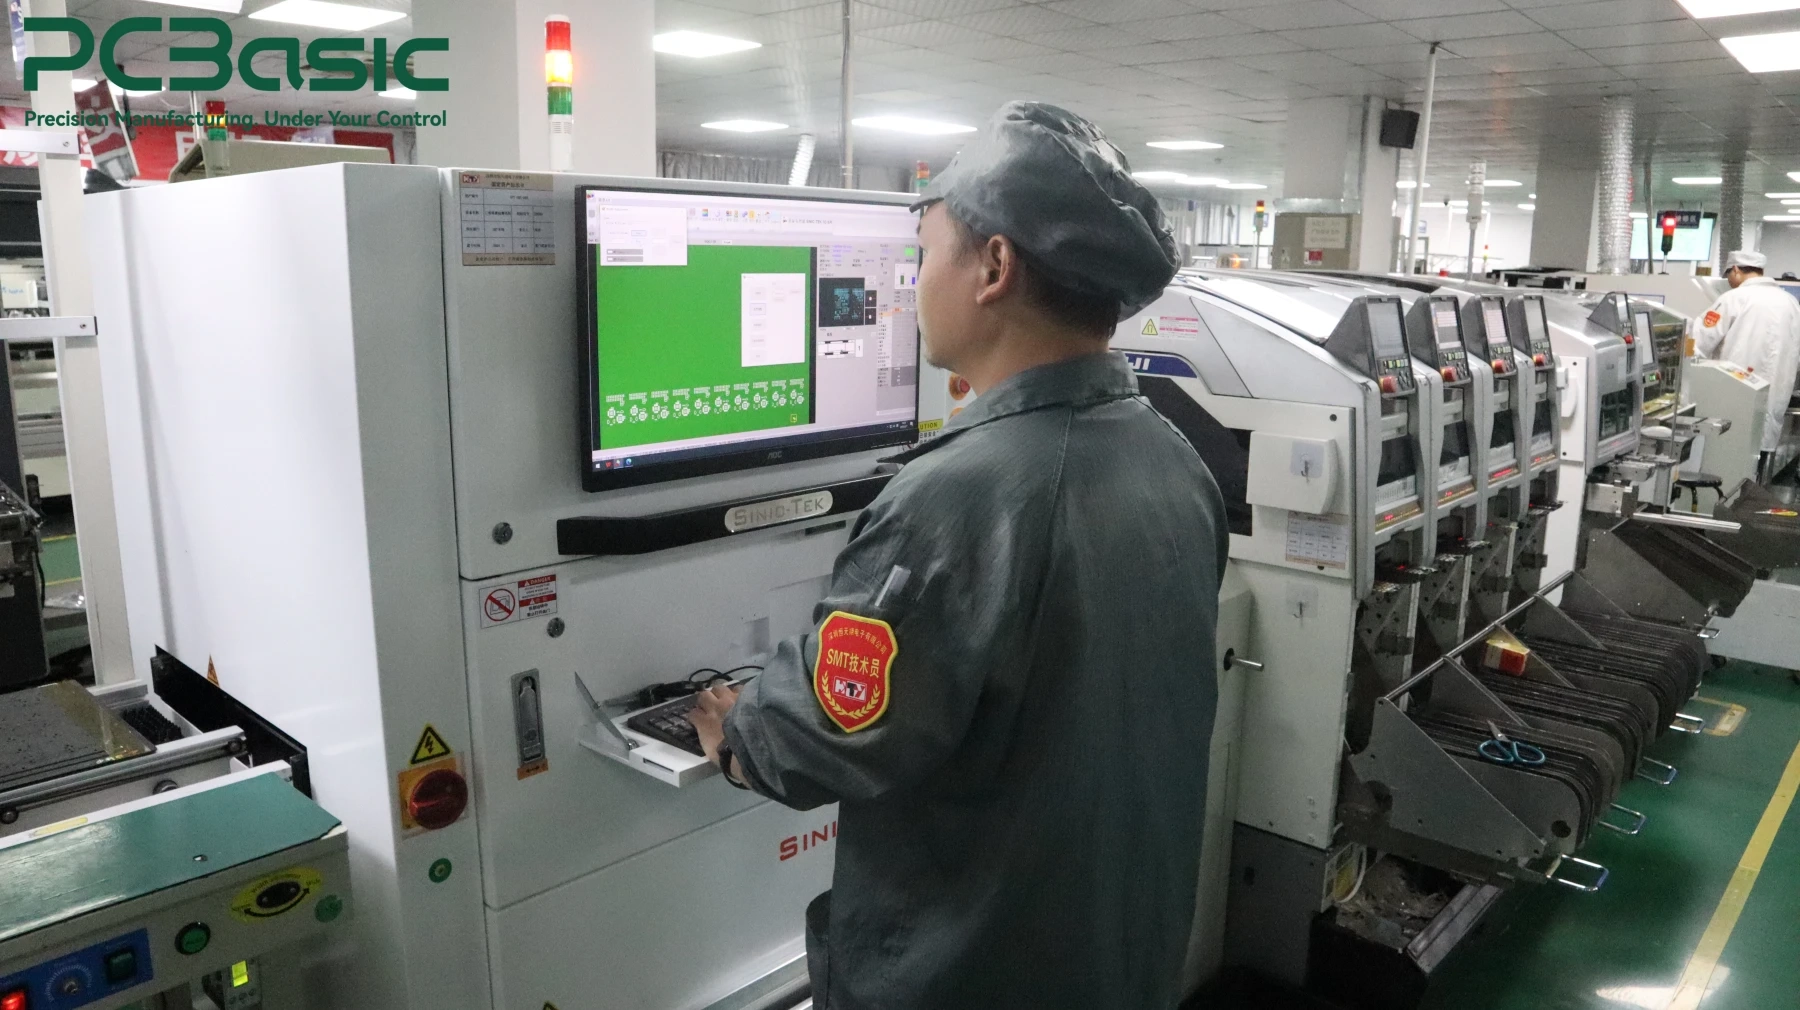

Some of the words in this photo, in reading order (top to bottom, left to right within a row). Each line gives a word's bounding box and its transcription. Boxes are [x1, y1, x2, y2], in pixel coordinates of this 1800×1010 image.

[767, 450, 782, 459] AOC
[826, 648, 880, 678] SMT技术员
